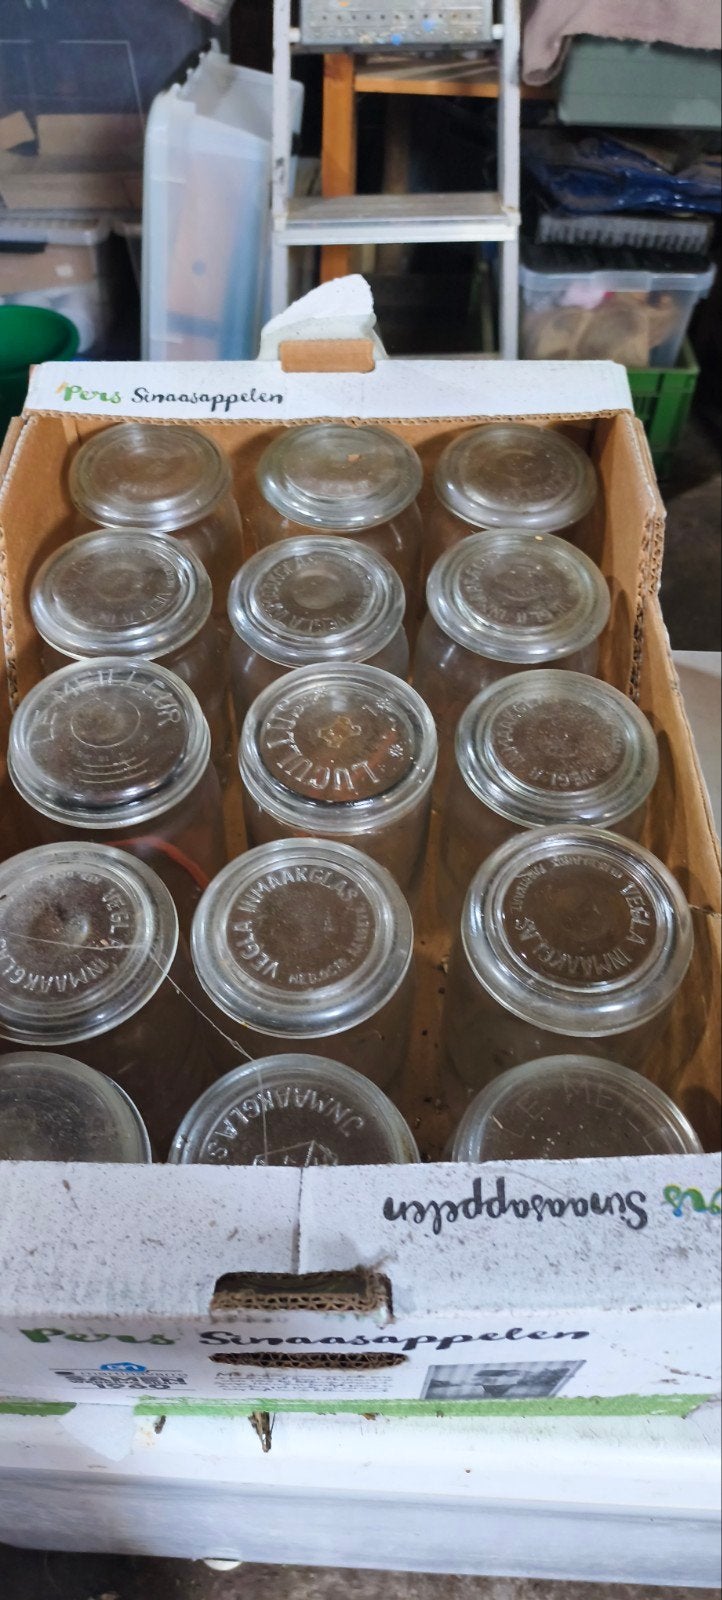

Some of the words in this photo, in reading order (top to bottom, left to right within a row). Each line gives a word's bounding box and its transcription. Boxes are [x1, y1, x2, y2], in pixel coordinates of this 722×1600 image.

[63, 384, 122, 404] Pers
[131, 386, 284, 412] Sinaasappelen
[266, 699, 380, 790] LUCULLUS
[102, 888, 130, 951] VEGLA
[238, 866, 359, 914] INMAAKGLAS
[620, 880, 651, 946] VEGLA
[233, 920, 280, 979] VEGLA
[514, 917, 633, 977] INMAAKGLAS
[382, 1176, 649, 1235] Sinaasappelen
[661, 1184, 722, 1218] ers
[19, 1327, 178, 1347] Pers
[200, 1327, 590, 1353] Sinaasappelen
